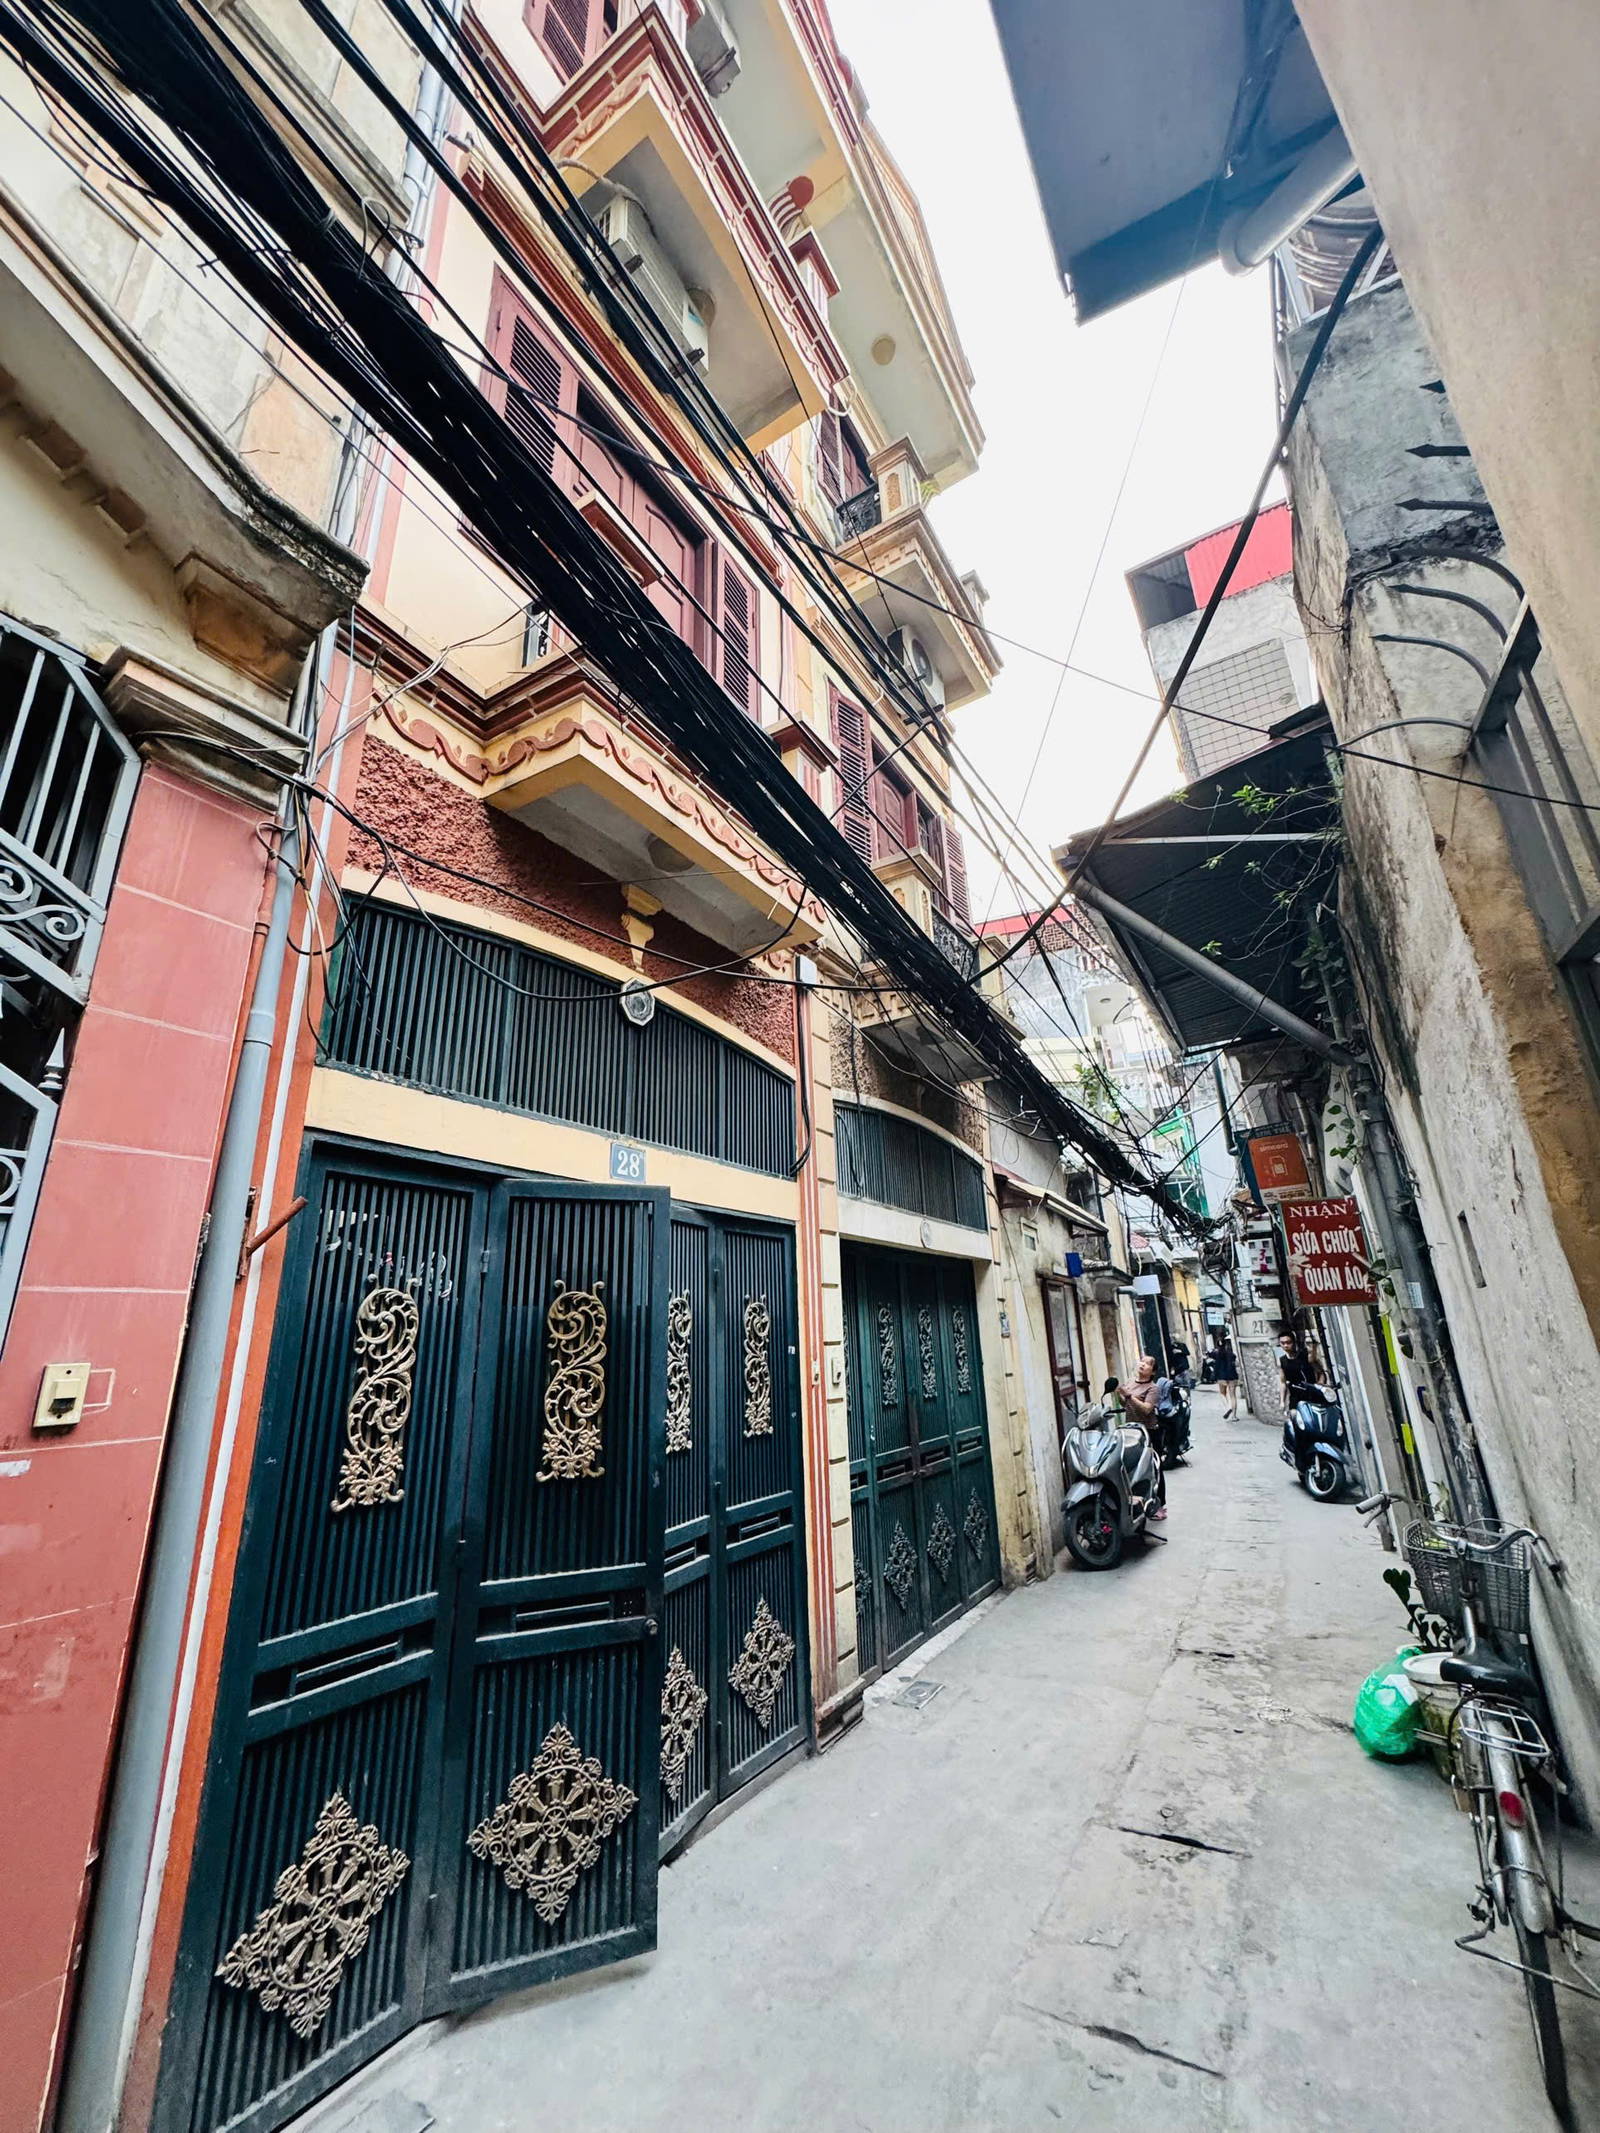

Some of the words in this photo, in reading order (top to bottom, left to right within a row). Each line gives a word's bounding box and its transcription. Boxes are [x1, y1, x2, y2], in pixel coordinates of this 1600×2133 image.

[617, 1150, 640, 1177] 28
[1289, 1201, 1347, 1219] NHẬN
[1292, 1223, 1321, 1255] SỬA
[1321, 1225, 1360, 1254] CHỮA
[1304, 1260, 1343, 1294] QUẦN
[1344, 1261, 1365, 1290] ÁO
